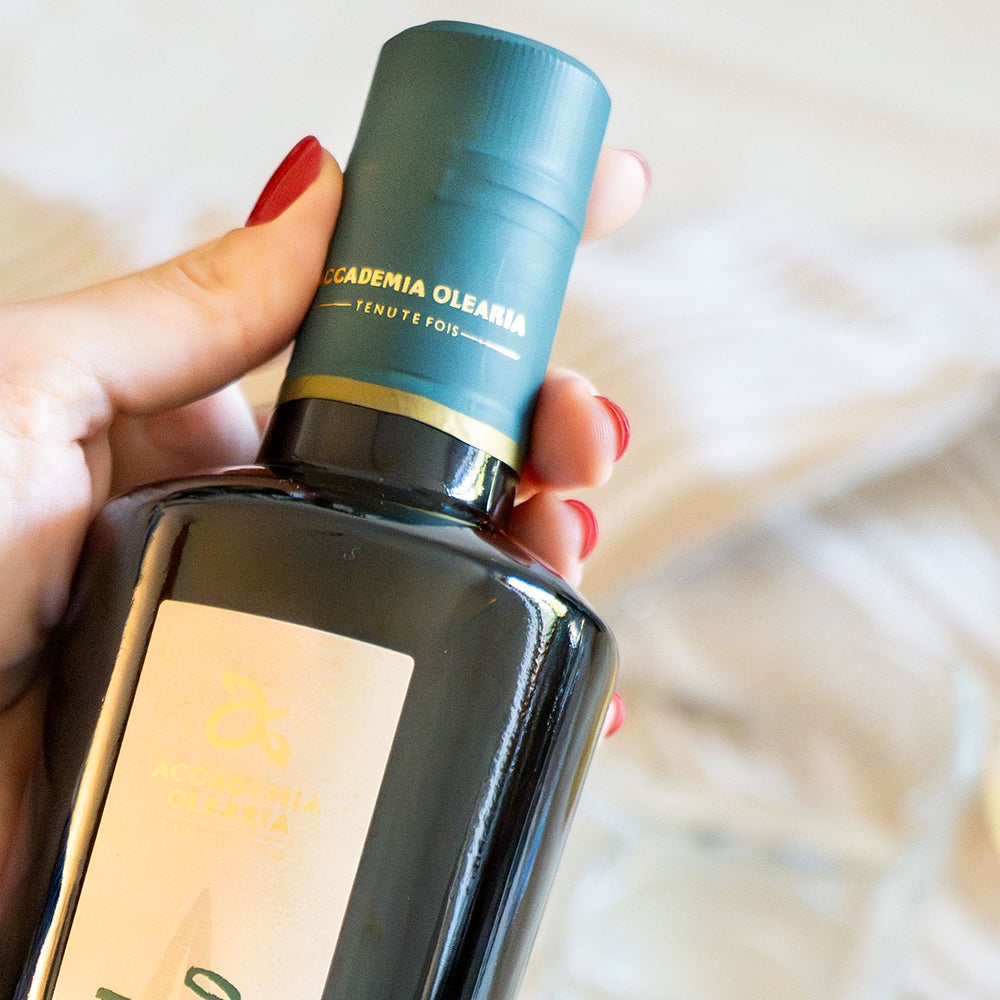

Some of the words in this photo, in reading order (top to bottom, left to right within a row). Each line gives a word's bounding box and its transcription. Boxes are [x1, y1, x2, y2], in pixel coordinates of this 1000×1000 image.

[321, 267, 425, 298] CCADEMIA
[432, 284, 526, 337] OLEARIA
[355, 299, 421, 325] TENUTE
[425, 316, 460, 337] FOIS
[167, 789, 290, 836] OLEARIA
